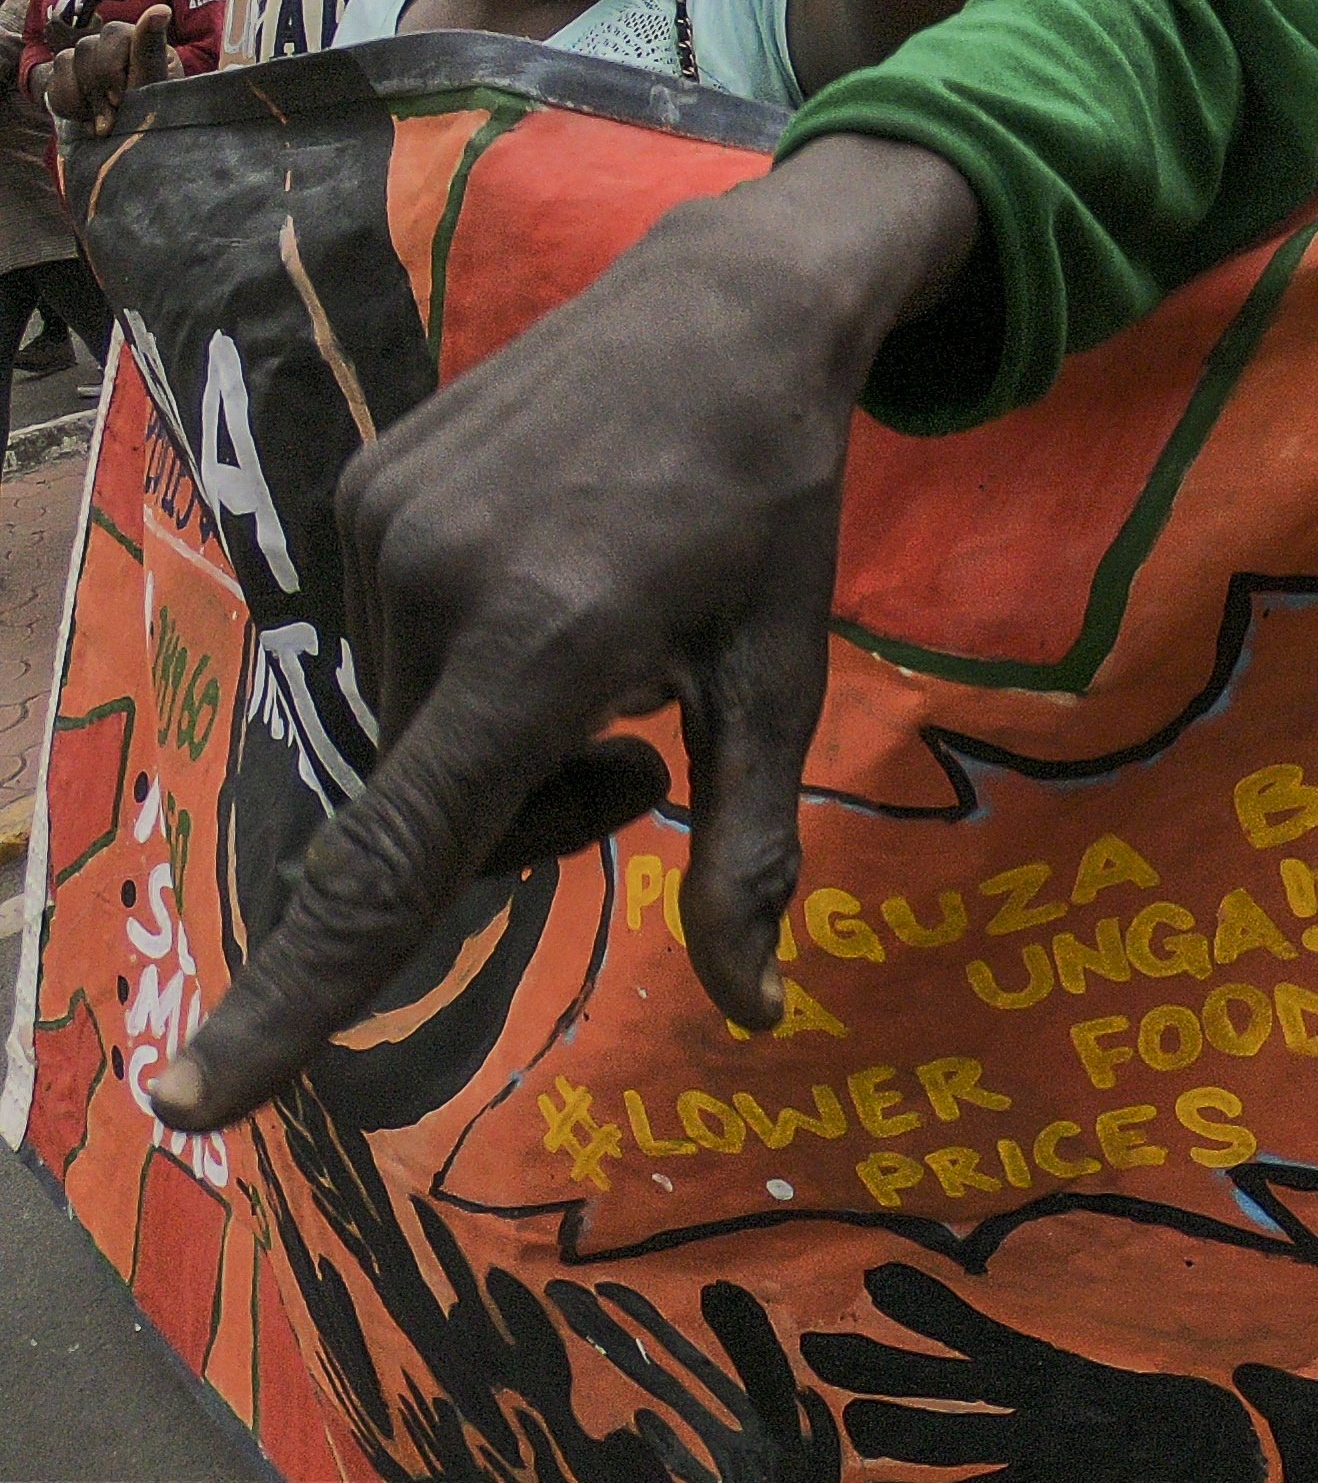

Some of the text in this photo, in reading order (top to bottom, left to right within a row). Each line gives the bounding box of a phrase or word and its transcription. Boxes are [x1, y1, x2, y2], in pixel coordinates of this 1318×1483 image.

[625, 831, 1160, 964] PGUZA
[539, 1055, 1012, 1192] #LOWER
[855, 1086, 1258, 1208] PRICES
